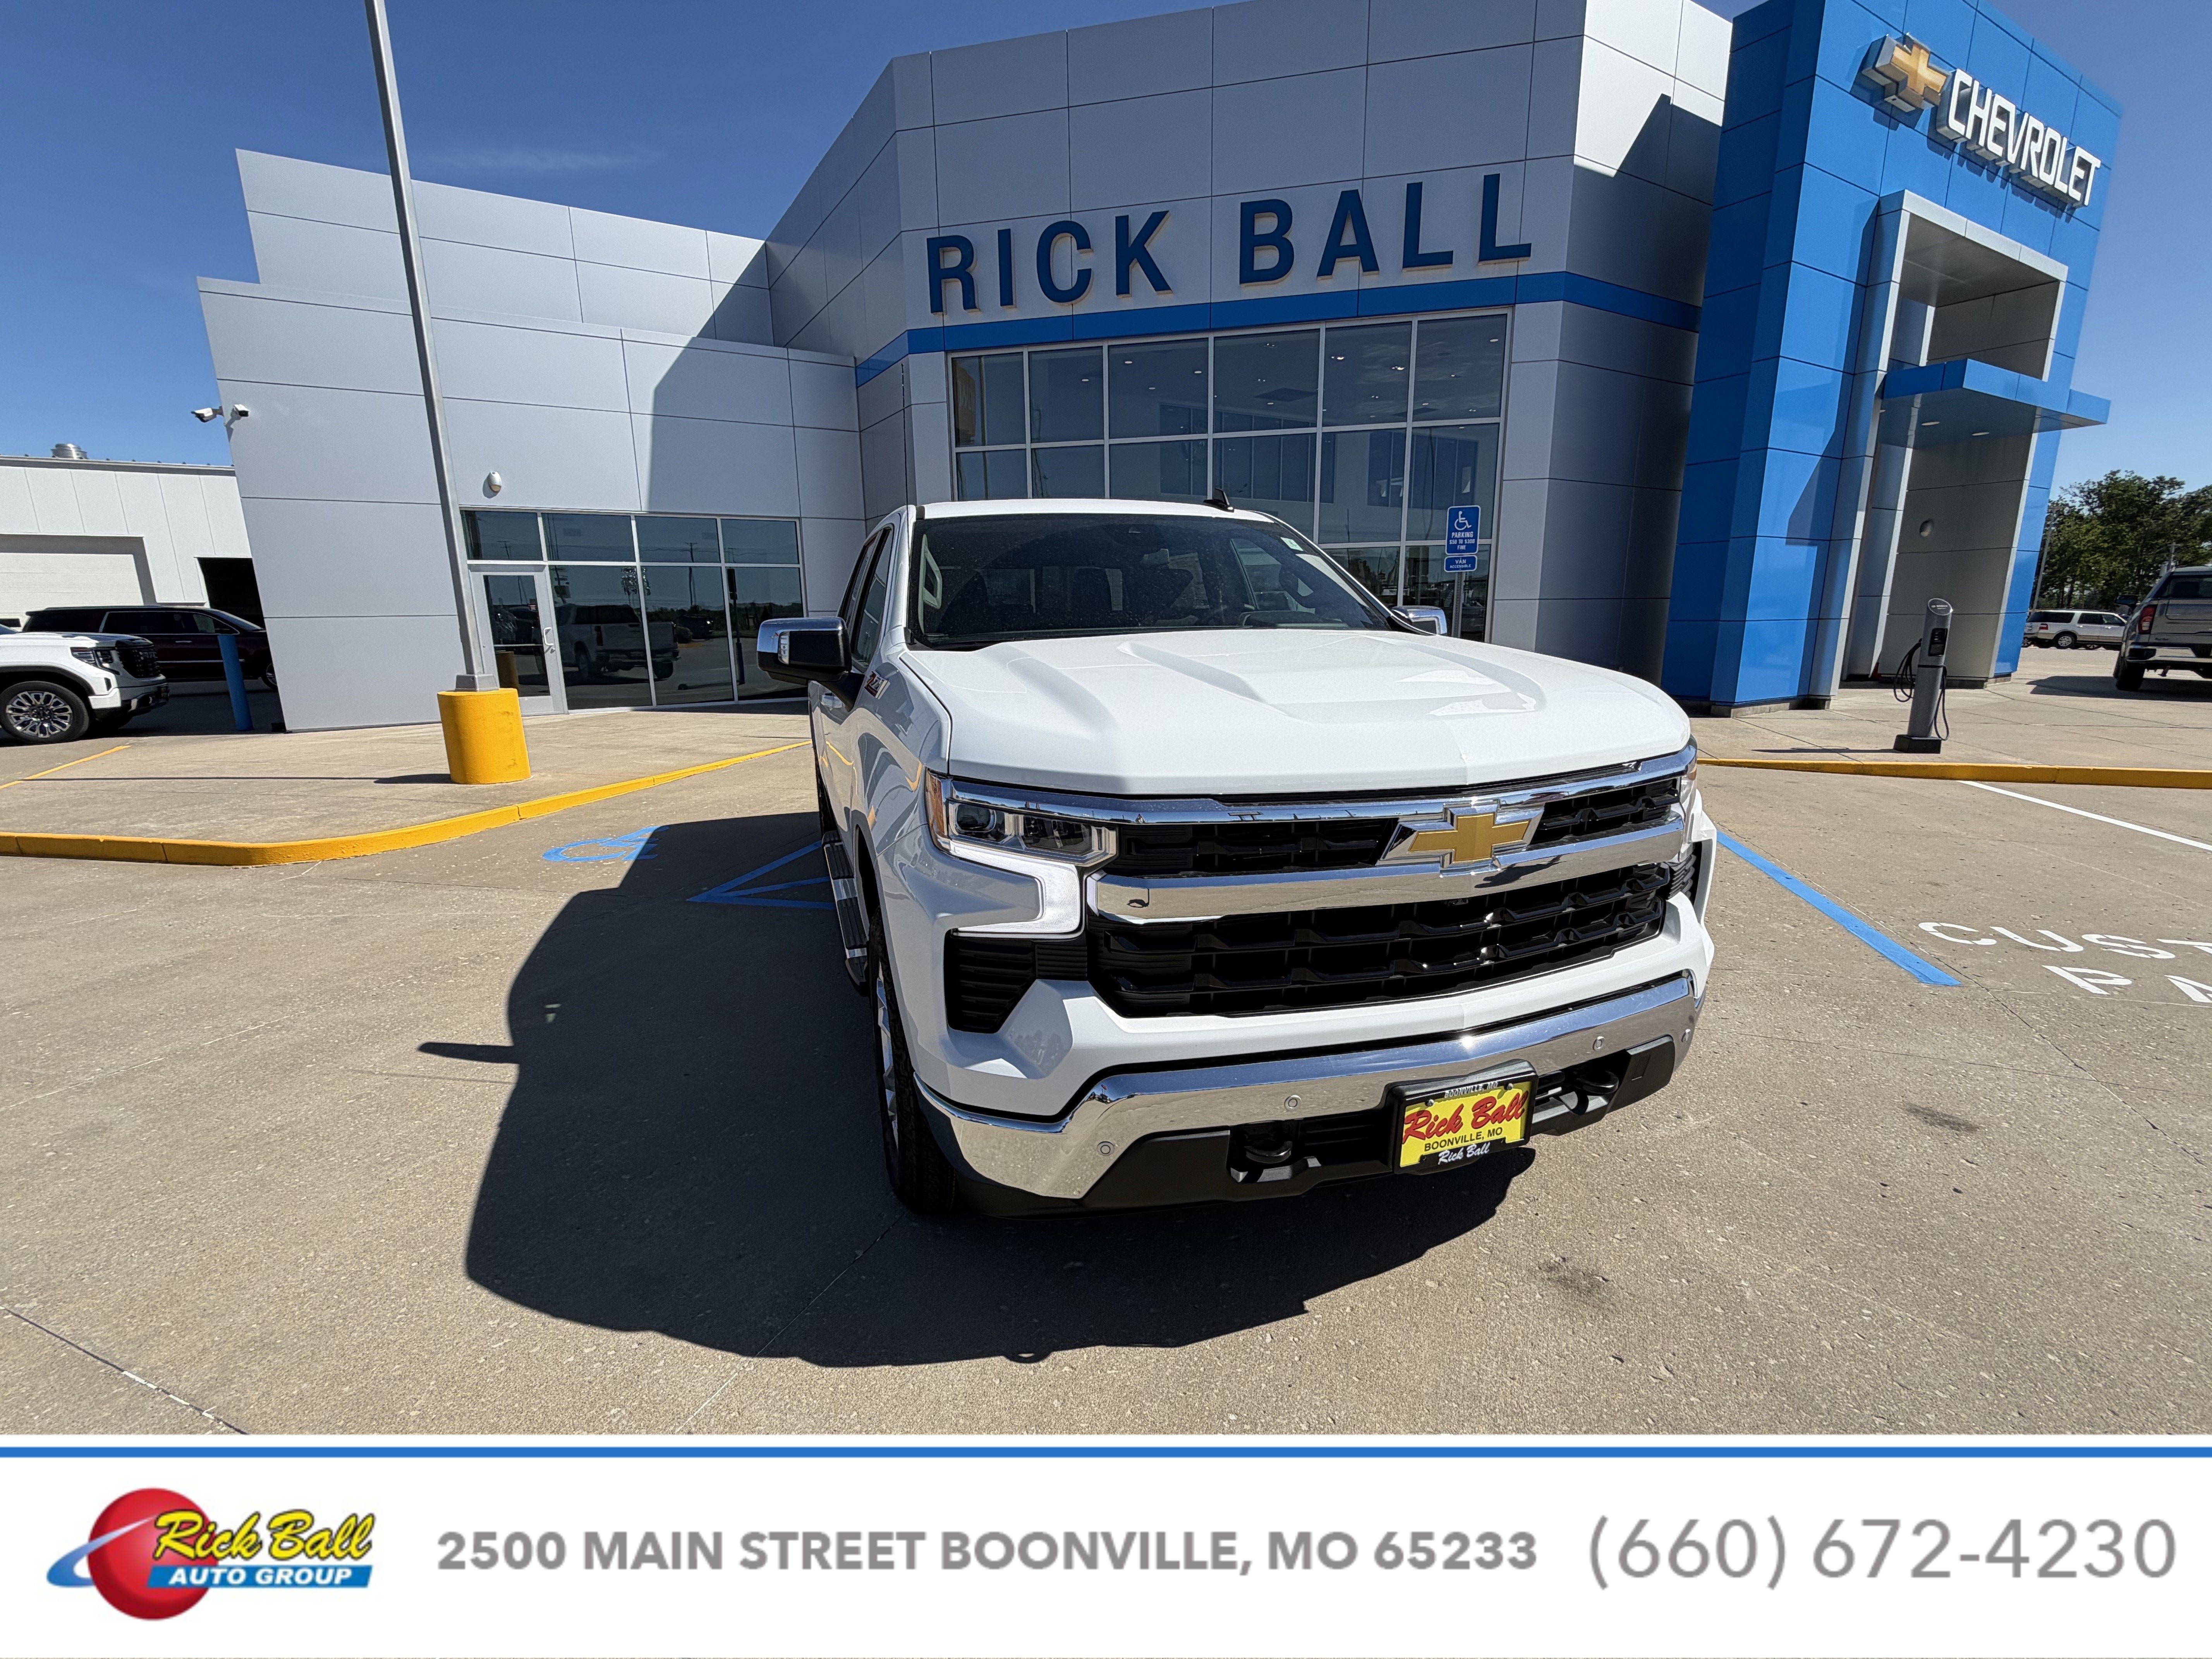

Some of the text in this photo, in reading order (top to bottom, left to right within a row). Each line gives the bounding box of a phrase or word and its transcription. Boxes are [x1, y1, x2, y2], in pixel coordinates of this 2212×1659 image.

[1946, 68, 2101, 206] CHEVROLET
[926, 173, 1532, 315] RICK BALL
[1444, 1081, 1498, 1098] BOONVILLE, MO
[1402, 1091, 1529, 1144] Rick Ball
[1424, 1127, 1503, 1152] BOONVILLE, MO
[1438, 1142, 1490, 1165] Rick Ball
